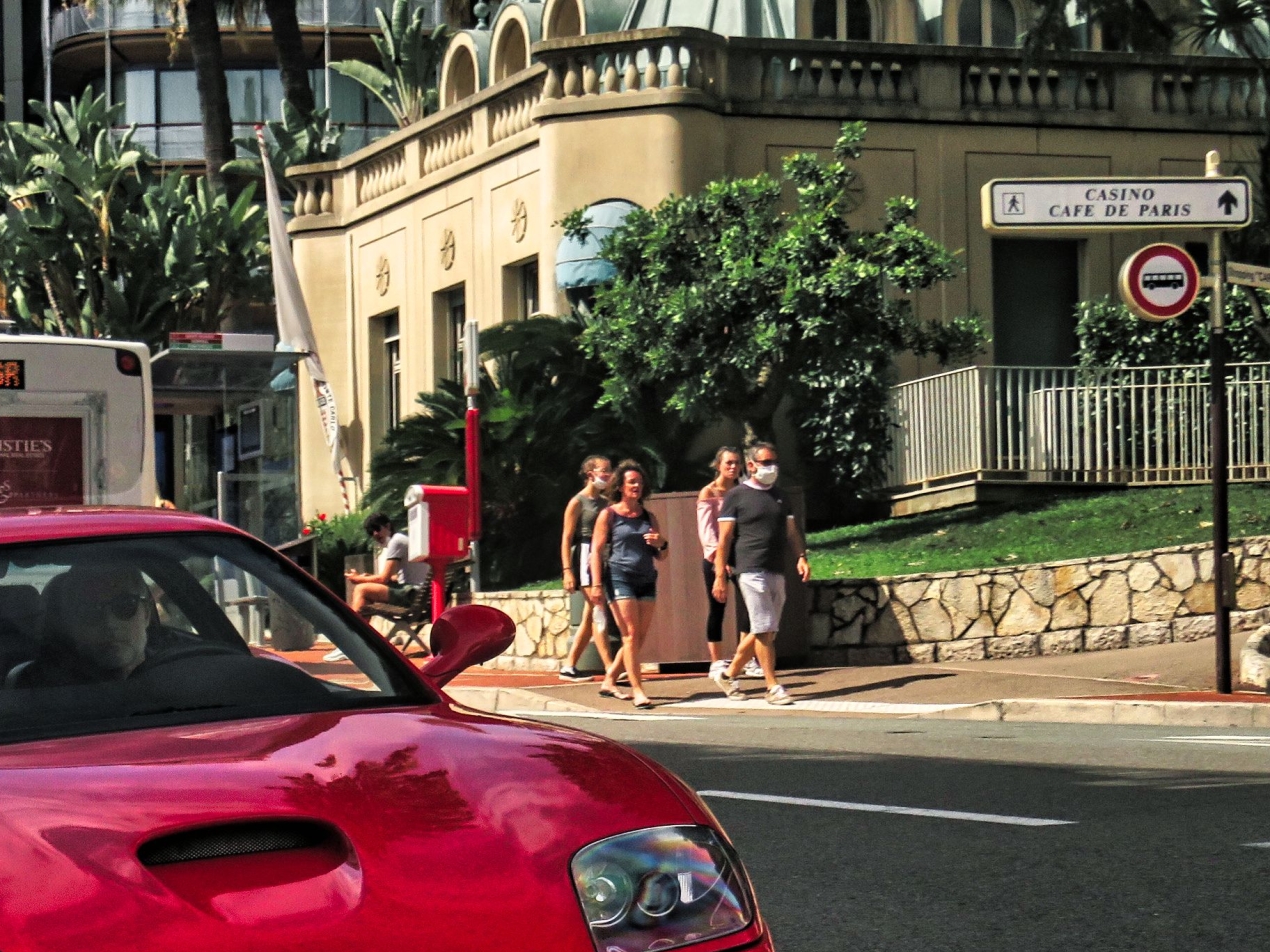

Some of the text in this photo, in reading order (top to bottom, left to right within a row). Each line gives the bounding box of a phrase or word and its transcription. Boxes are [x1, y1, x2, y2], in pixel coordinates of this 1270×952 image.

[1085, 188, 1155, 201] CASINO
[1049, 203, 1192, 217] CAFE DE PARIS
